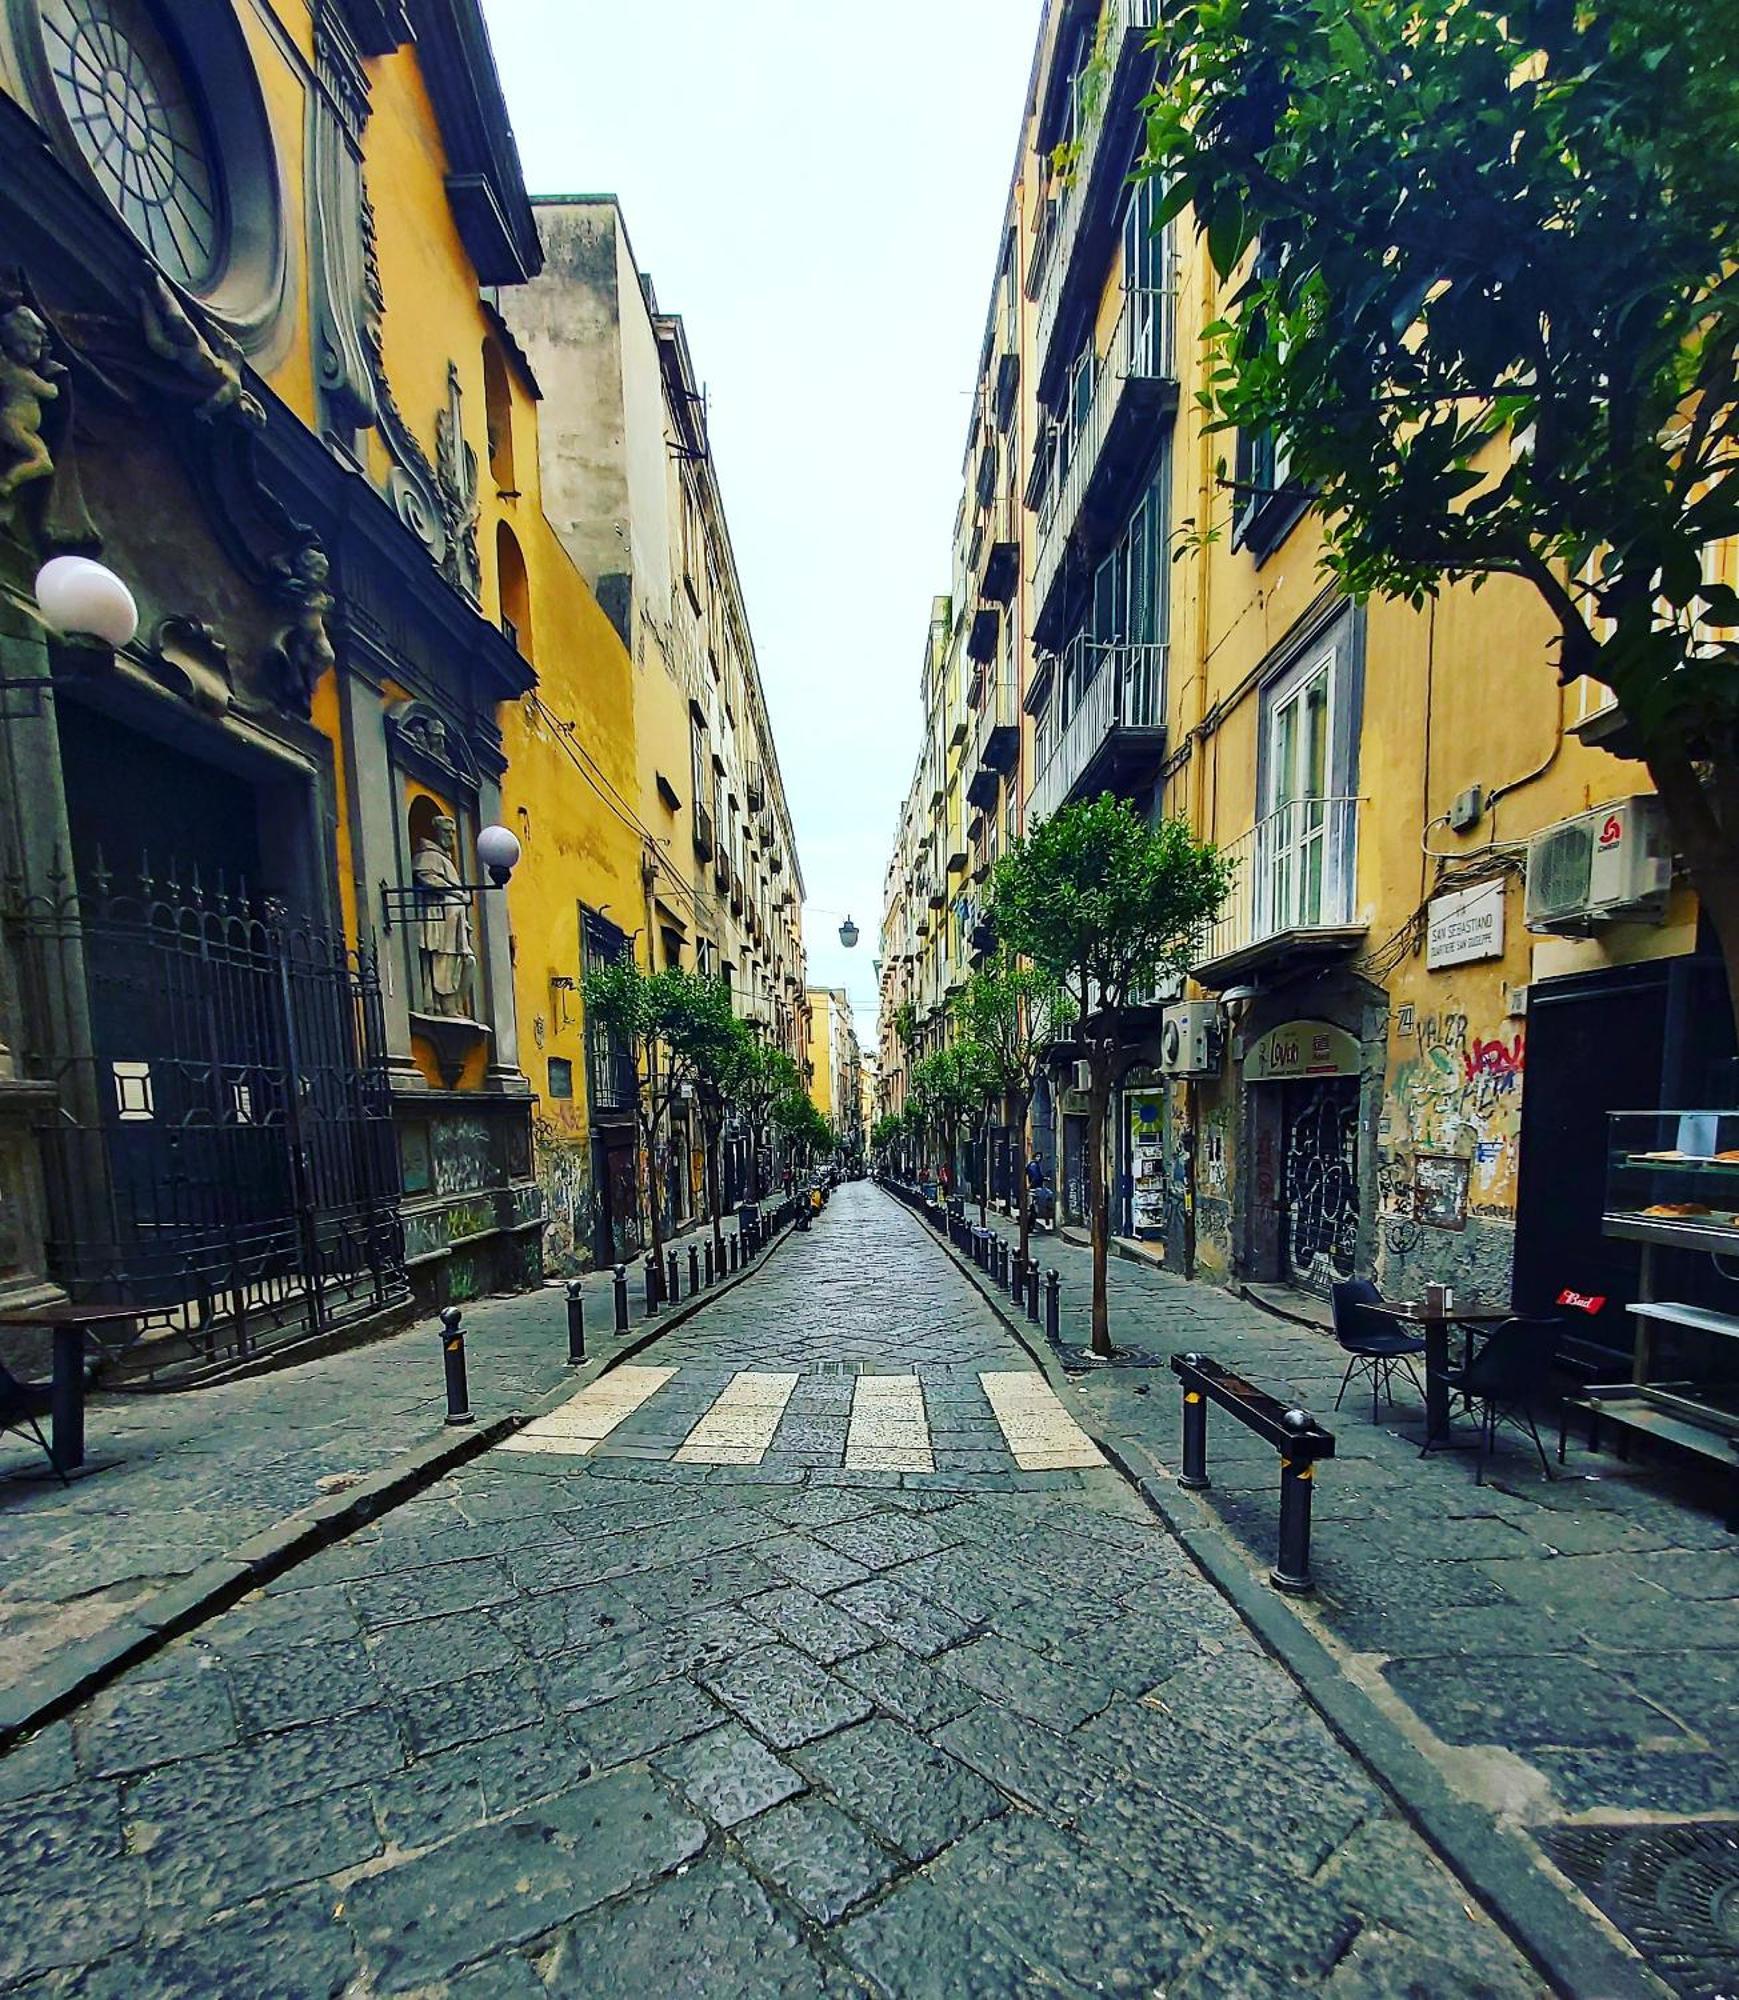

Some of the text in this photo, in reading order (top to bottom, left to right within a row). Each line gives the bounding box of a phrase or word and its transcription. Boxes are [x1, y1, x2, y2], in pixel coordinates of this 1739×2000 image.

[1432, 913, 1493, 942] SAN SEBASTIANO
[1397, 1007, 1414, 1032] 74
[1563, 1290, 1594, 1308] Bud
